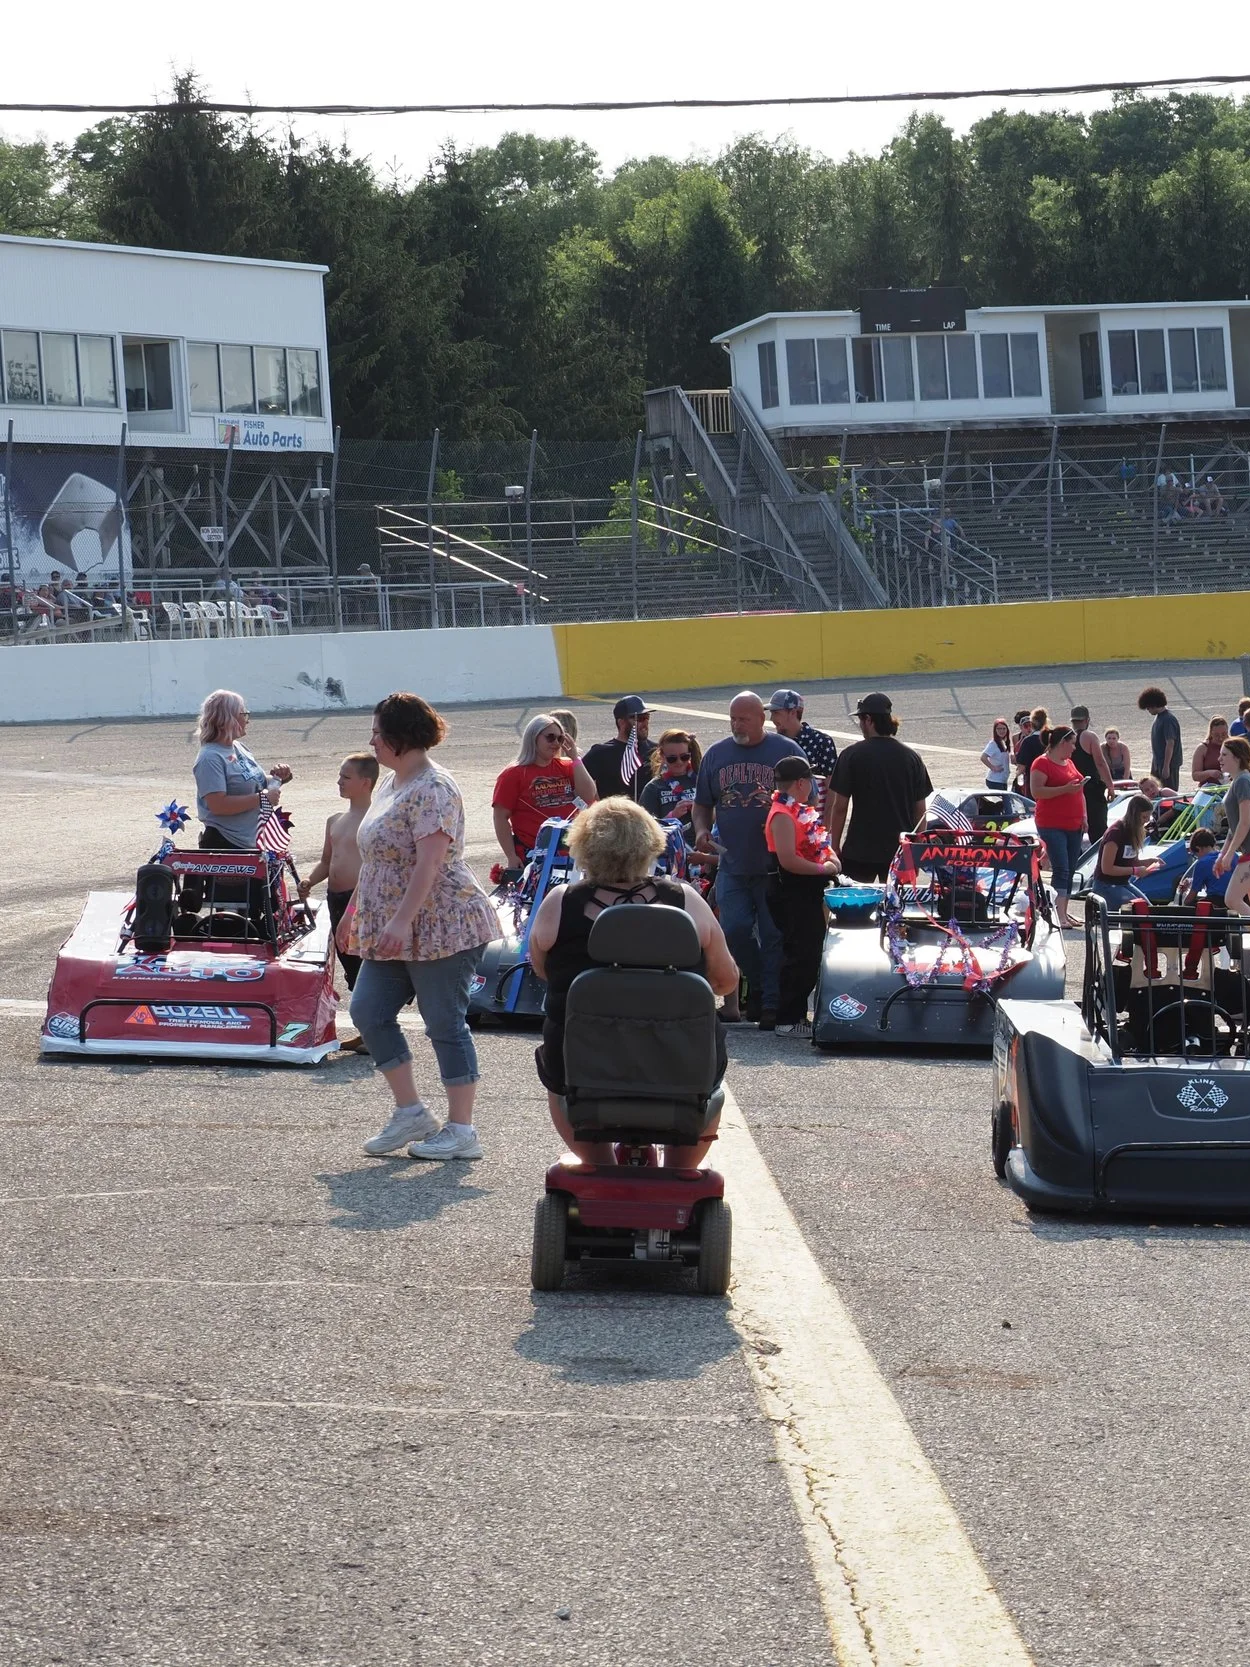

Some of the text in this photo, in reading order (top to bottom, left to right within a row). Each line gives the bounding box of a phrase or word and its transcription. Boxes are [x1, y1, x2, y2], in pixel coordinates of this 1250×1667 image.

[875, 321, 956, 332] TIME LAP
[243, 420, 265, 430] FISHER
[242, 430, 303, 449] Auto Parts
[719, 762, 775, 791] REALTREE
[920, 846, 1018, 863] ANTHONY
[191, 863, 257, 875] ANDREWS
[115, 964, 266, 982] AUTO
[832, 999, 861, 1016] SIGN
[845, 998, 860, 1008] MR
[152, 1005, 252, 1021] BOZELL
[50, 1018, 81, 1034] SIGN
[158, 1021, 252, 1030] PROPERTY MANAGEMENT
[276, 1021, 311, 1043] 7
[1187, 1078, 1216, 1086] KLINE
[1189, 1105, 1218, 1114] Racing
